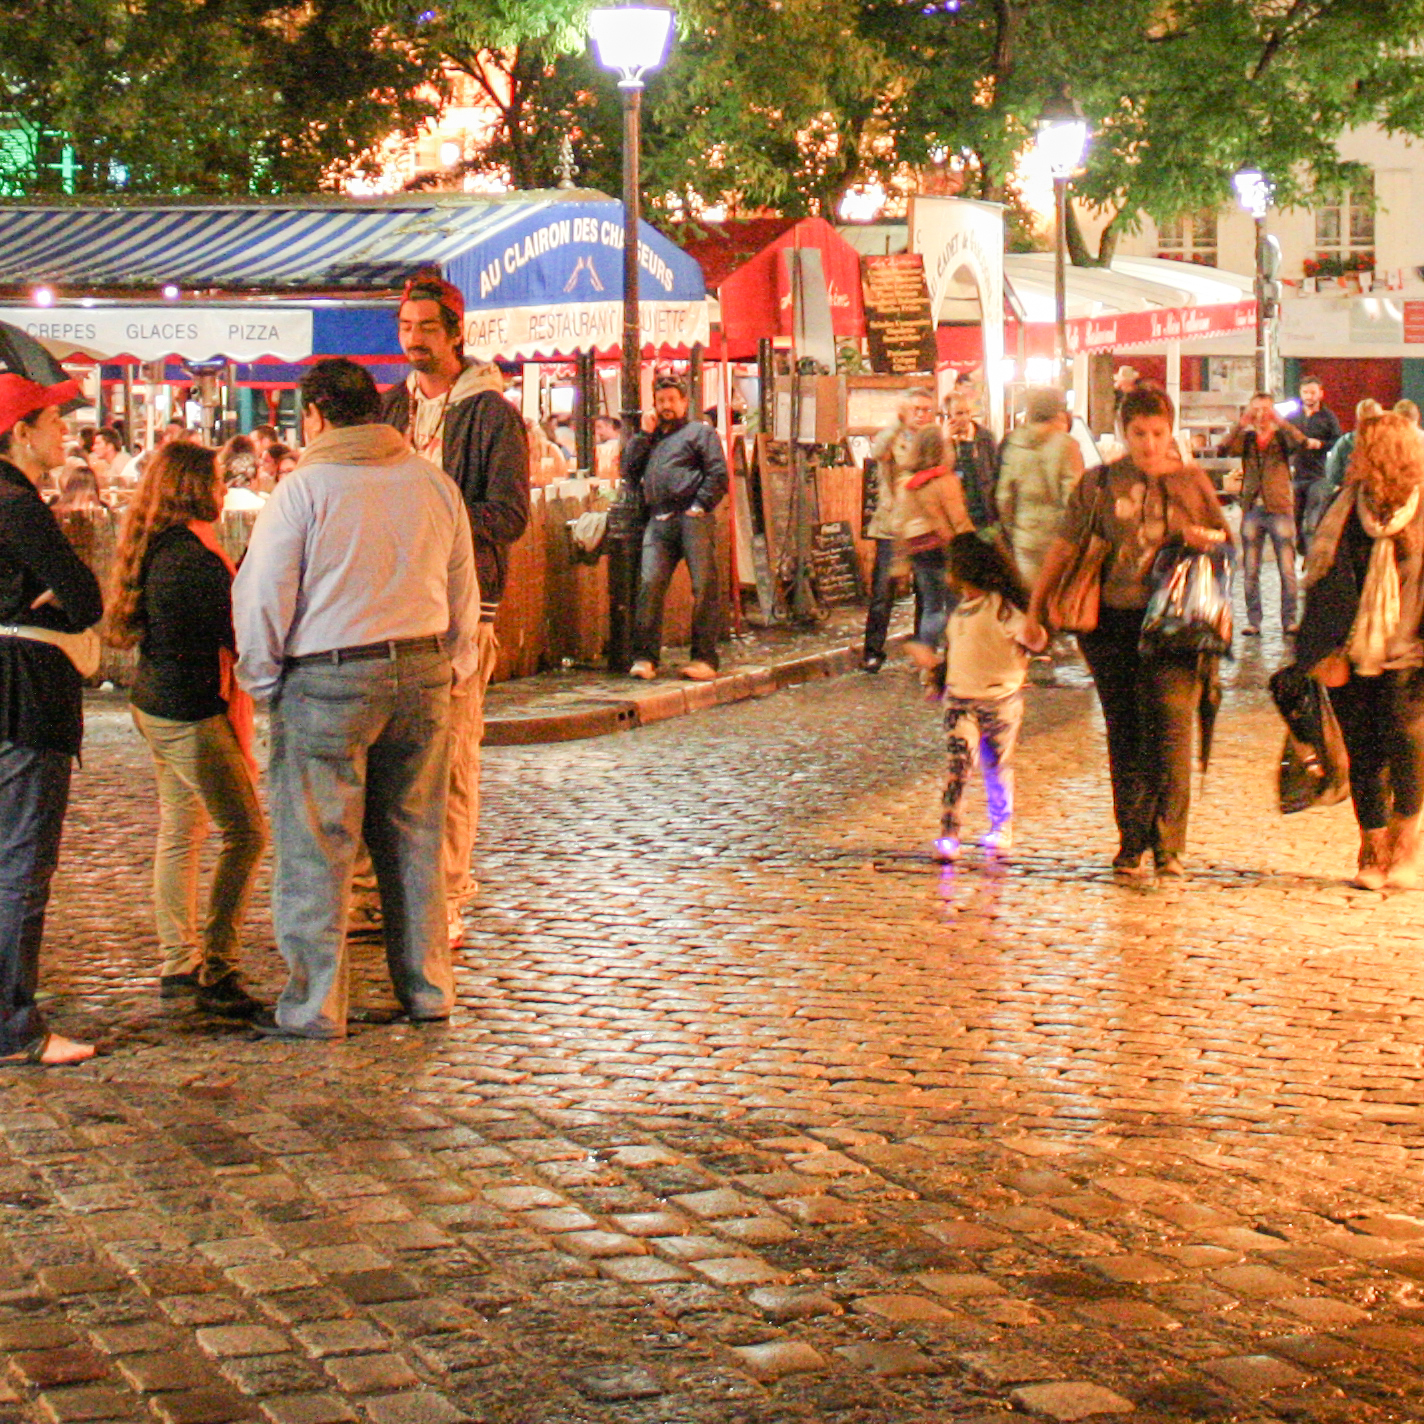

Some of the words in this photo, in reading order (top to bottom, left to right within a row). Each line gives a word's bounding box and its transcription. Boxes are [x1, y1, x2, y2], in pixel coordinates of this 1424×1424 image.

[480, 258, 502, 299] AU
[503, 219, 570, 273] CLAIRON
[573, 217, 598, 242] DES
[601, 220, 674, 291] CHAEURS
[26, 323, 96, 339] CREPES
[126, 323, 198, 339] GLACES
[228, 324, 280, 340] PIZZA
[529, 309, 615, 340] RESTAURANT
[638, 308, 685, 333] UVETTE
